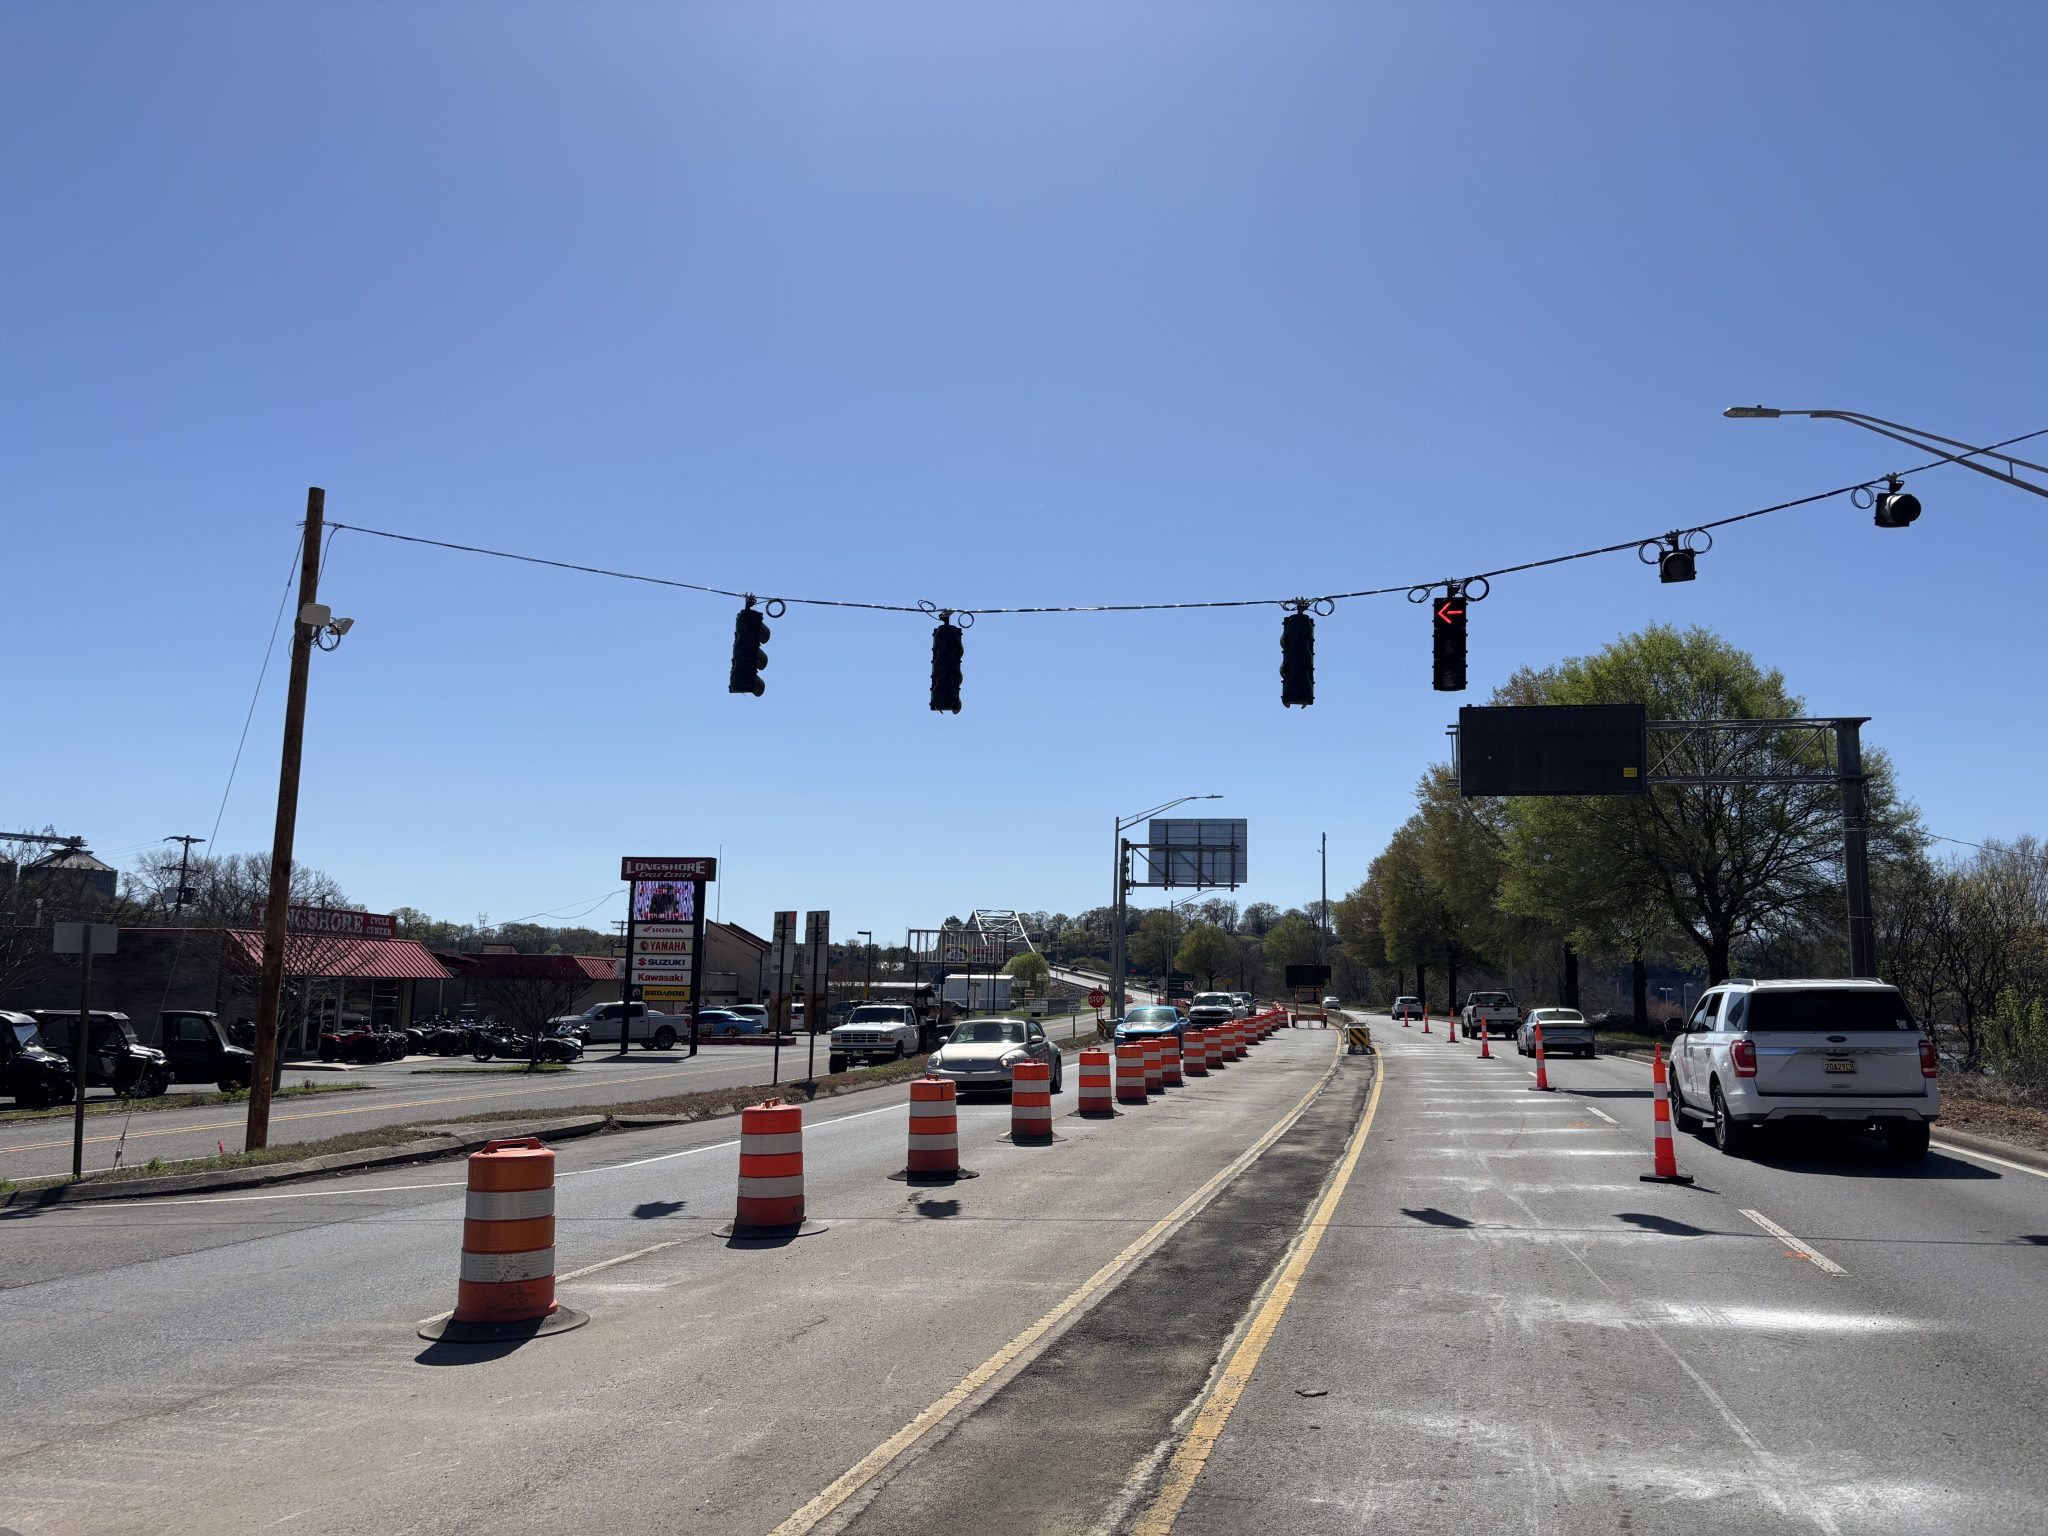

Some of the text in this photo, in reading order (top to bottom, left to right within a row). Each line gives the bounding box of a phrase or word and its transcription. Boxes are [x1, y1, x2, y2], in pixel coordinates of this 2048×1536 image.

[626, 861, 705, 874] LONGSHORE
[258, 906, 363, 933] LNGSHORE
[369, 917, 389, 926] CYCLE
[366, 926, 392, 936] CENTER
[650, 941, 686, 952] YAMAHA
[638, 973, 684, 982] Kawasaki
[1088, 995, 1105, 1003] STOP
